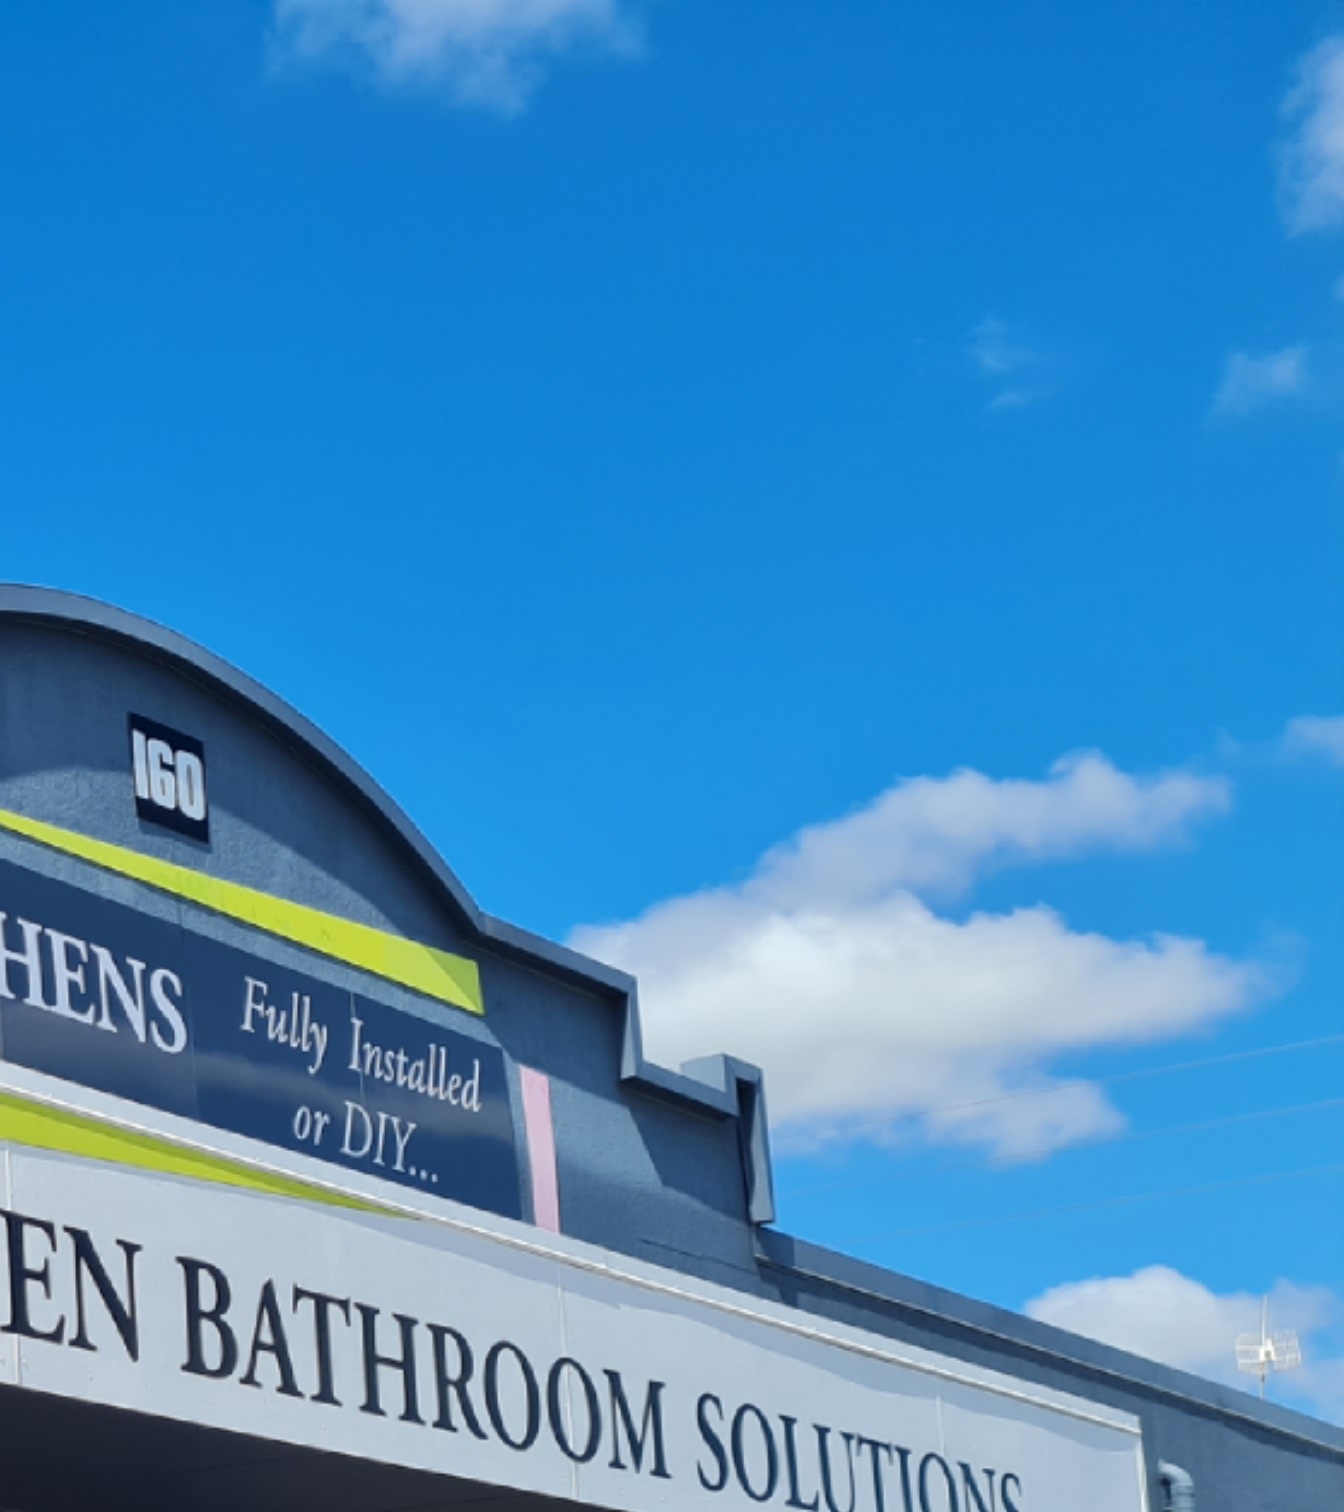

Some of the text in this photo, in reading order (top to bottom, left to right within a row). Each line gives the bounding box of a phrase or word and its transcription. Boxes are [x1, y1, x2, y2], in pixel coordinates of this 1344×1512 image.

[132, 728, 205, 821] 160
[240, 976, 482, 1112] Fully Installed
[294, 1100, 438, 1182] or DIY...
[176, 1256, 672, 1478] BATHROOM
